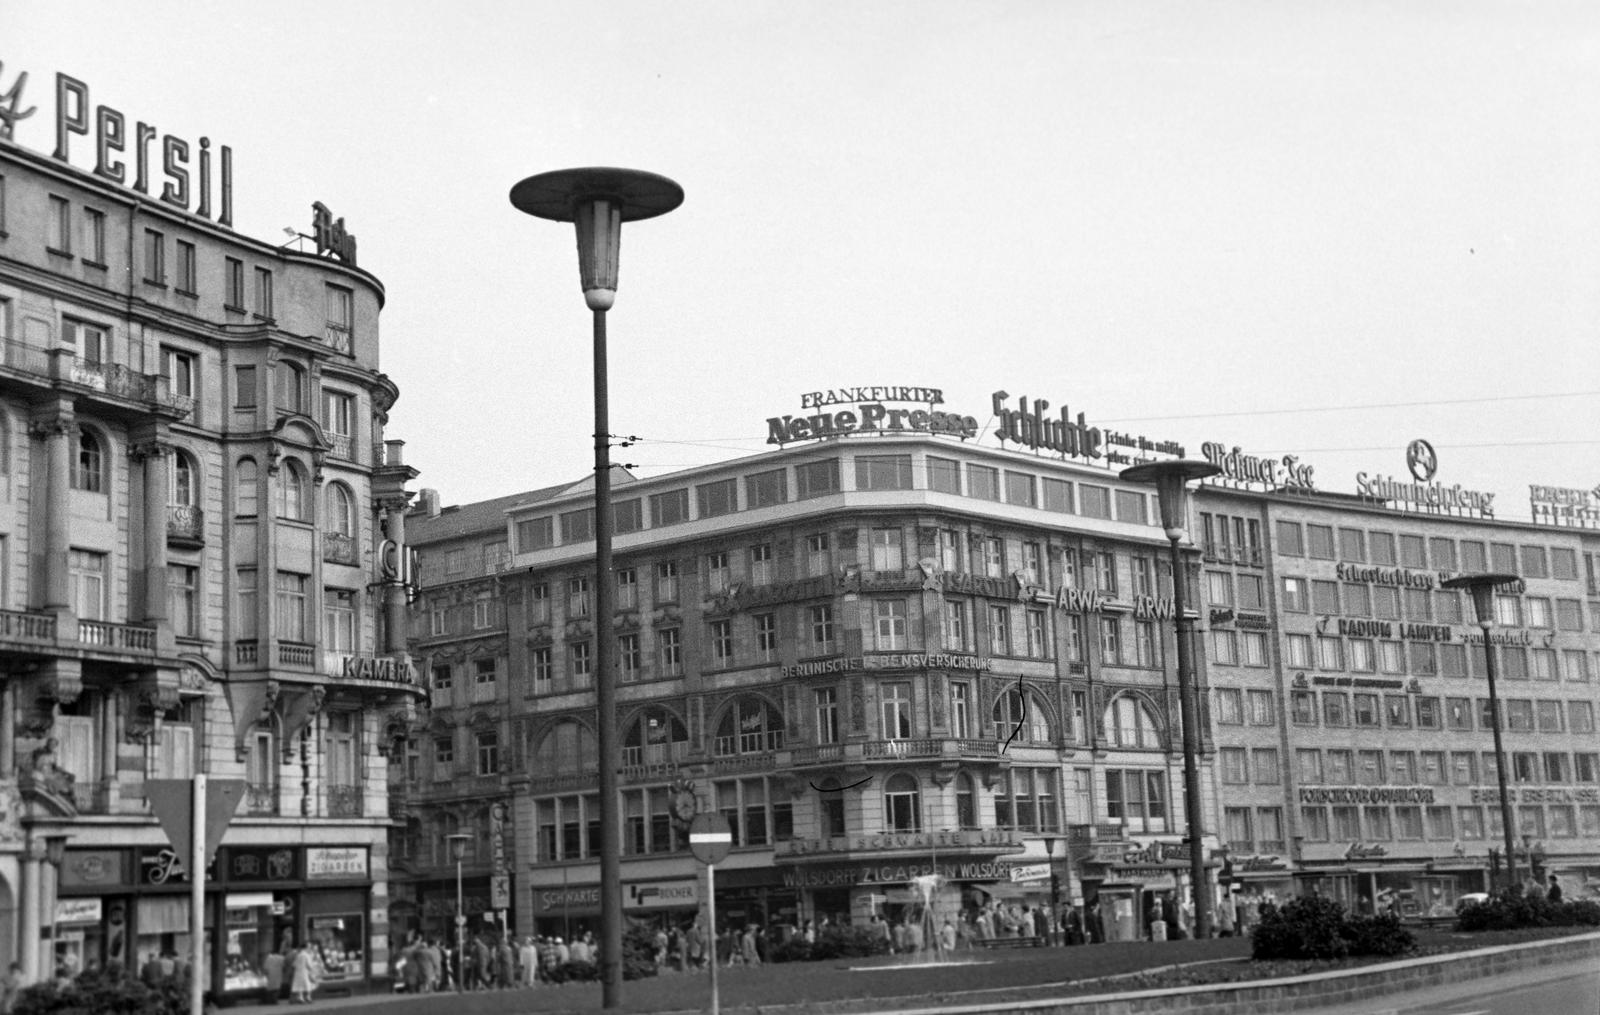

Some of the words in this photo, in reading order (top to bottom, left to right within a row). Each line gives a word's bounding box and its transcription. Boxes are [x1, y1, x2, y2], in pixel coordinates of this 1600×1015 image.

[53, 71, 233, 228] Persil
[801, 386, 944, 409] FRANKFURTER
[766, 410, 857, 444] Neue
[859, 404, 979, 438] Presse
[992, 390, 1102, 459] Schlichte
[1356, 471, 1495, 516] Schimmelpfeng
[1336, 561, 1433, 589] Scharlachberg
[1058, 586, 1101, 613] ARWA
[1136, 596, 1176, 619] ARWA
[1338, 618, 1391, 638] RADIUM
[1400, 623, 1450, 641] LAMPEN
[343, 656, 413, 684] KAMERA
[781, 658, 856, 678] BERLINISCHE
[783, 871, 857, 887] WOLSDORFF
[863, 864, 956, 882] ZIGARREN
[961, 862, 1013, 879] WOLSDORFF
[542, 889, 599, 911] SCHWARTE
